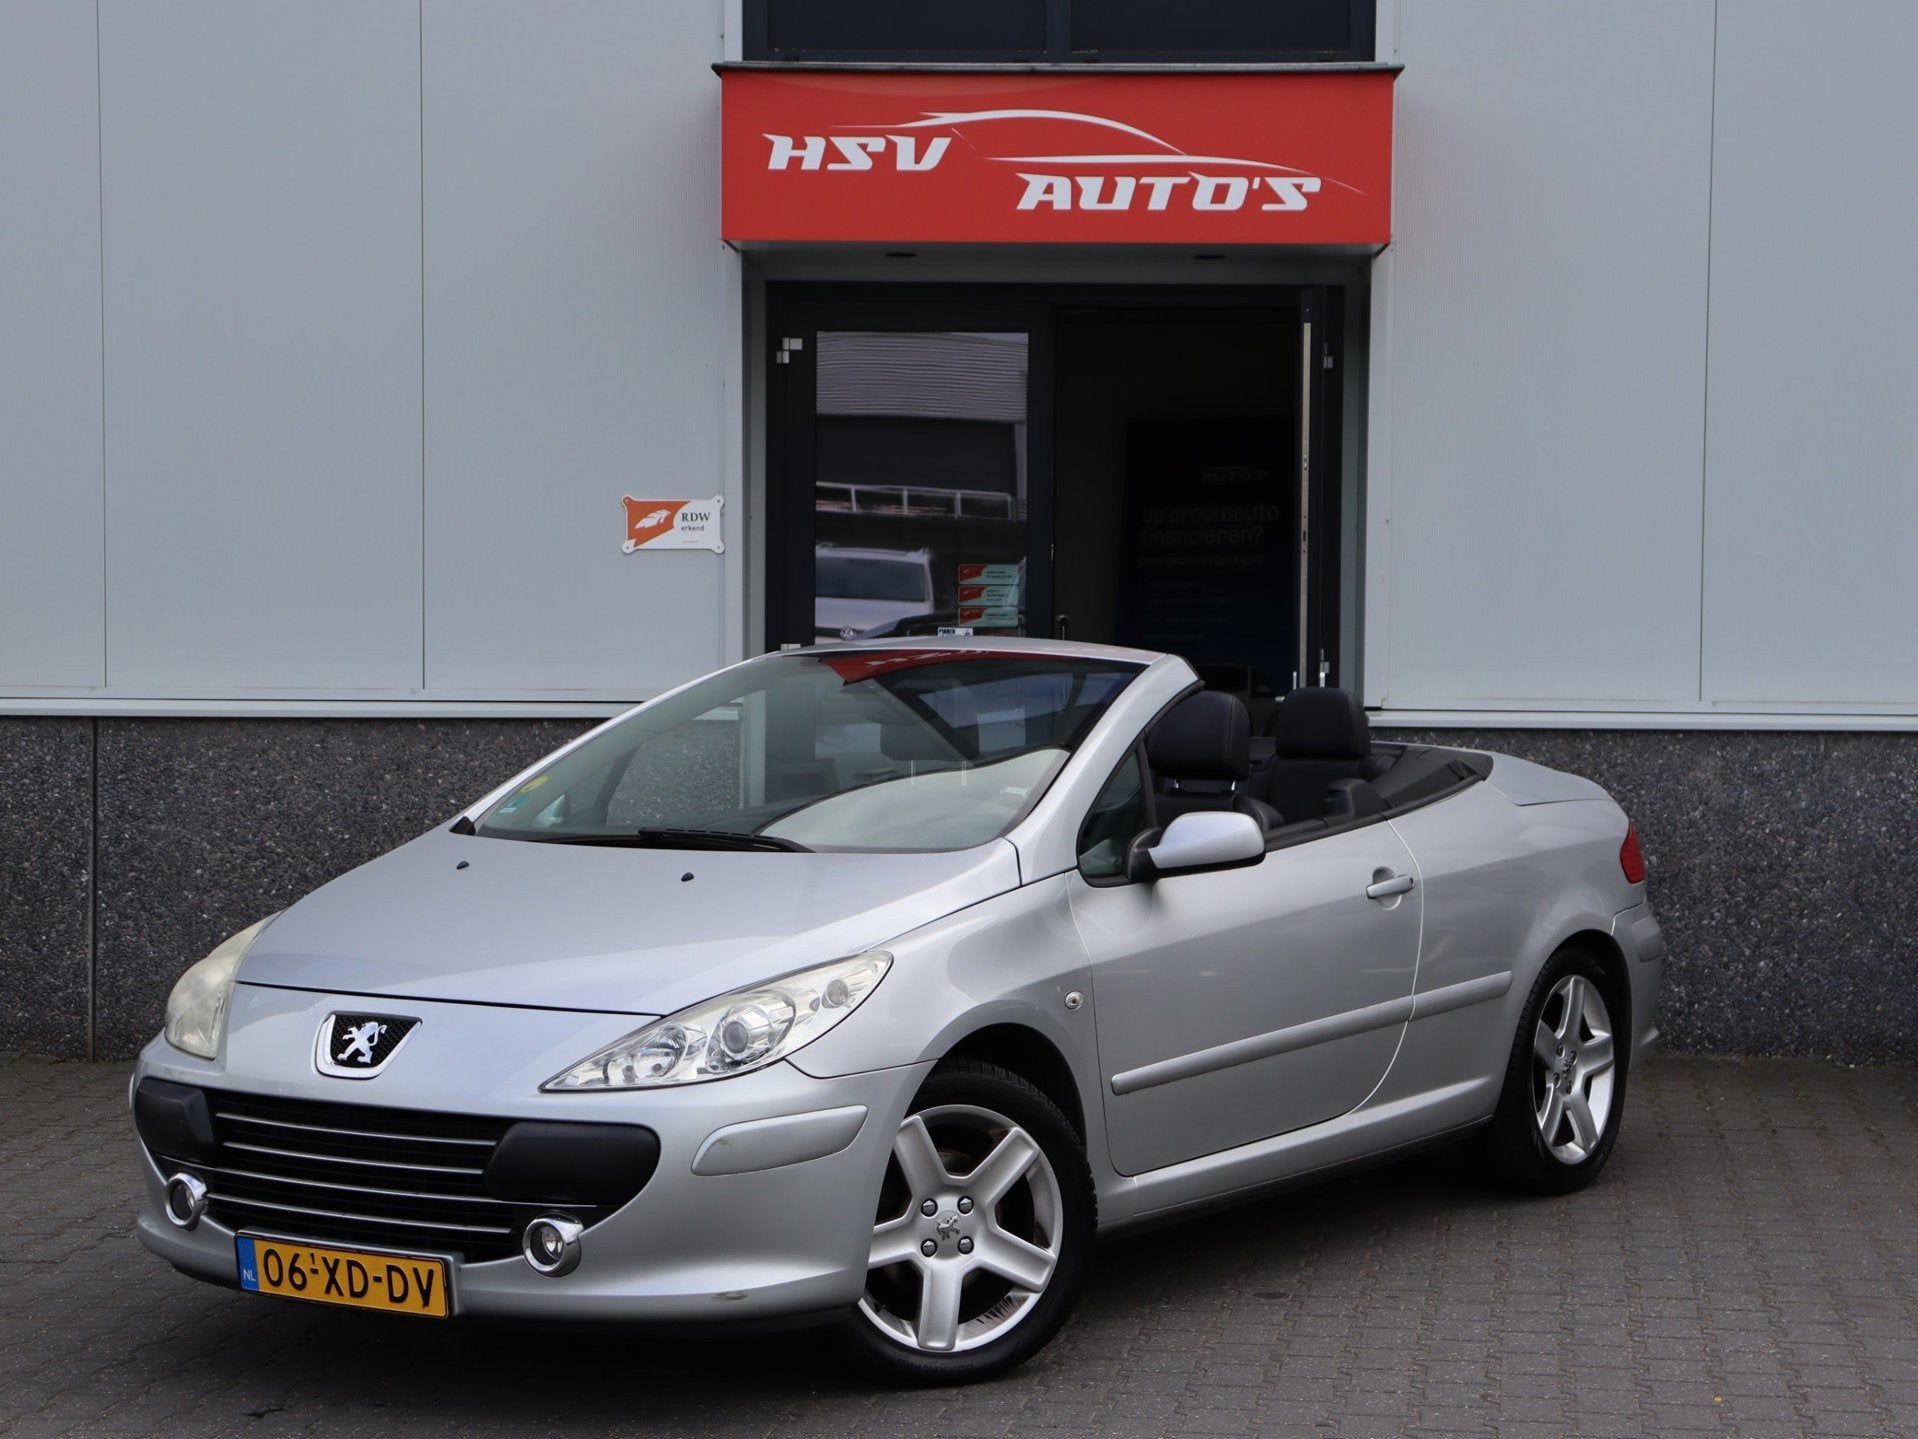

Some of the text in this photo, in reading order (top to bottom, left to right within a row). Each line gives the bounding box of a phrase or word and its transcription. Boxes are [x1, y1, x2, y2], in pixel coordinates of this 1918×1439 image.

[762, 133, 952, 171] HSV
[1016, 172, 1322, 211] AUTO'S
[681, 512, 711, 522] RDW
[1142, 503, 1280, 524] Je droomauto
[681, 524, 705, 532] erkend
[1140, 525, 1264, 546] financieren?
[243, 1269, 257, 1281] NL
[263, 1248, 434, 1308] 06-XD-DV
